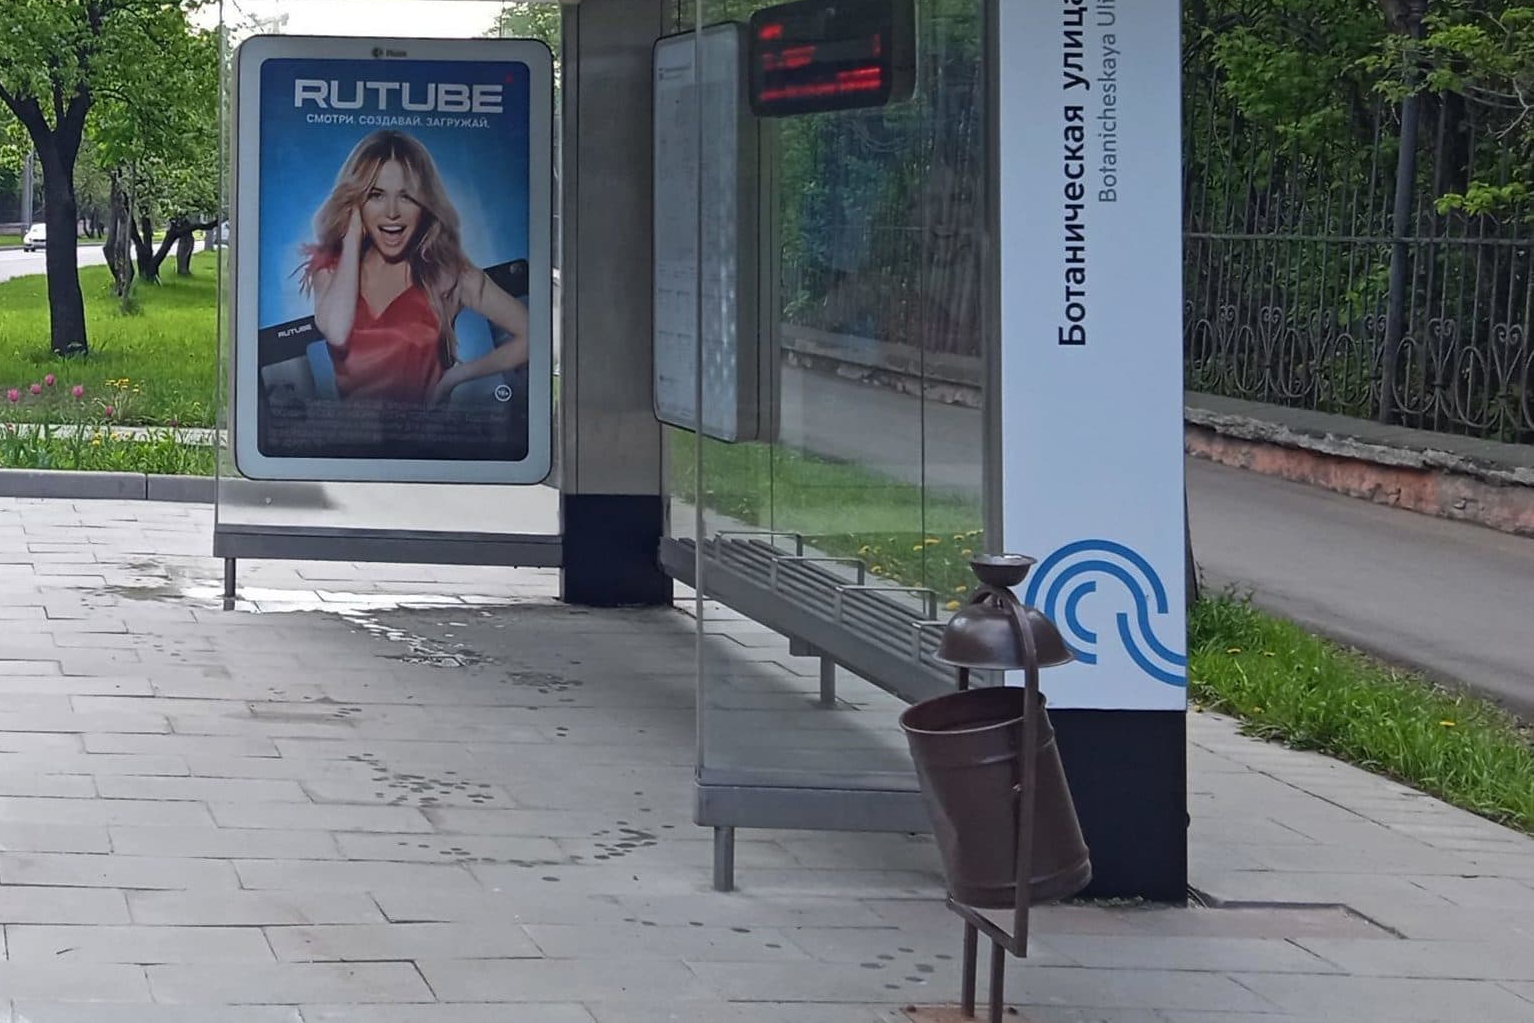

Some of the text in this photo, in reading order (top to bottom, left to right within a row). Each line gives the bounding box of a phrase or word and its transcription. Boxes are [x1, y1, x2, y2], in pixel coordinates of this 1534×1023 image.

[294, 79, 503, 114] RUTUBE
[1098, 33, 1121, 202] Botanicheskaya
[1058, 105, 1086, 345] Ботаническая
